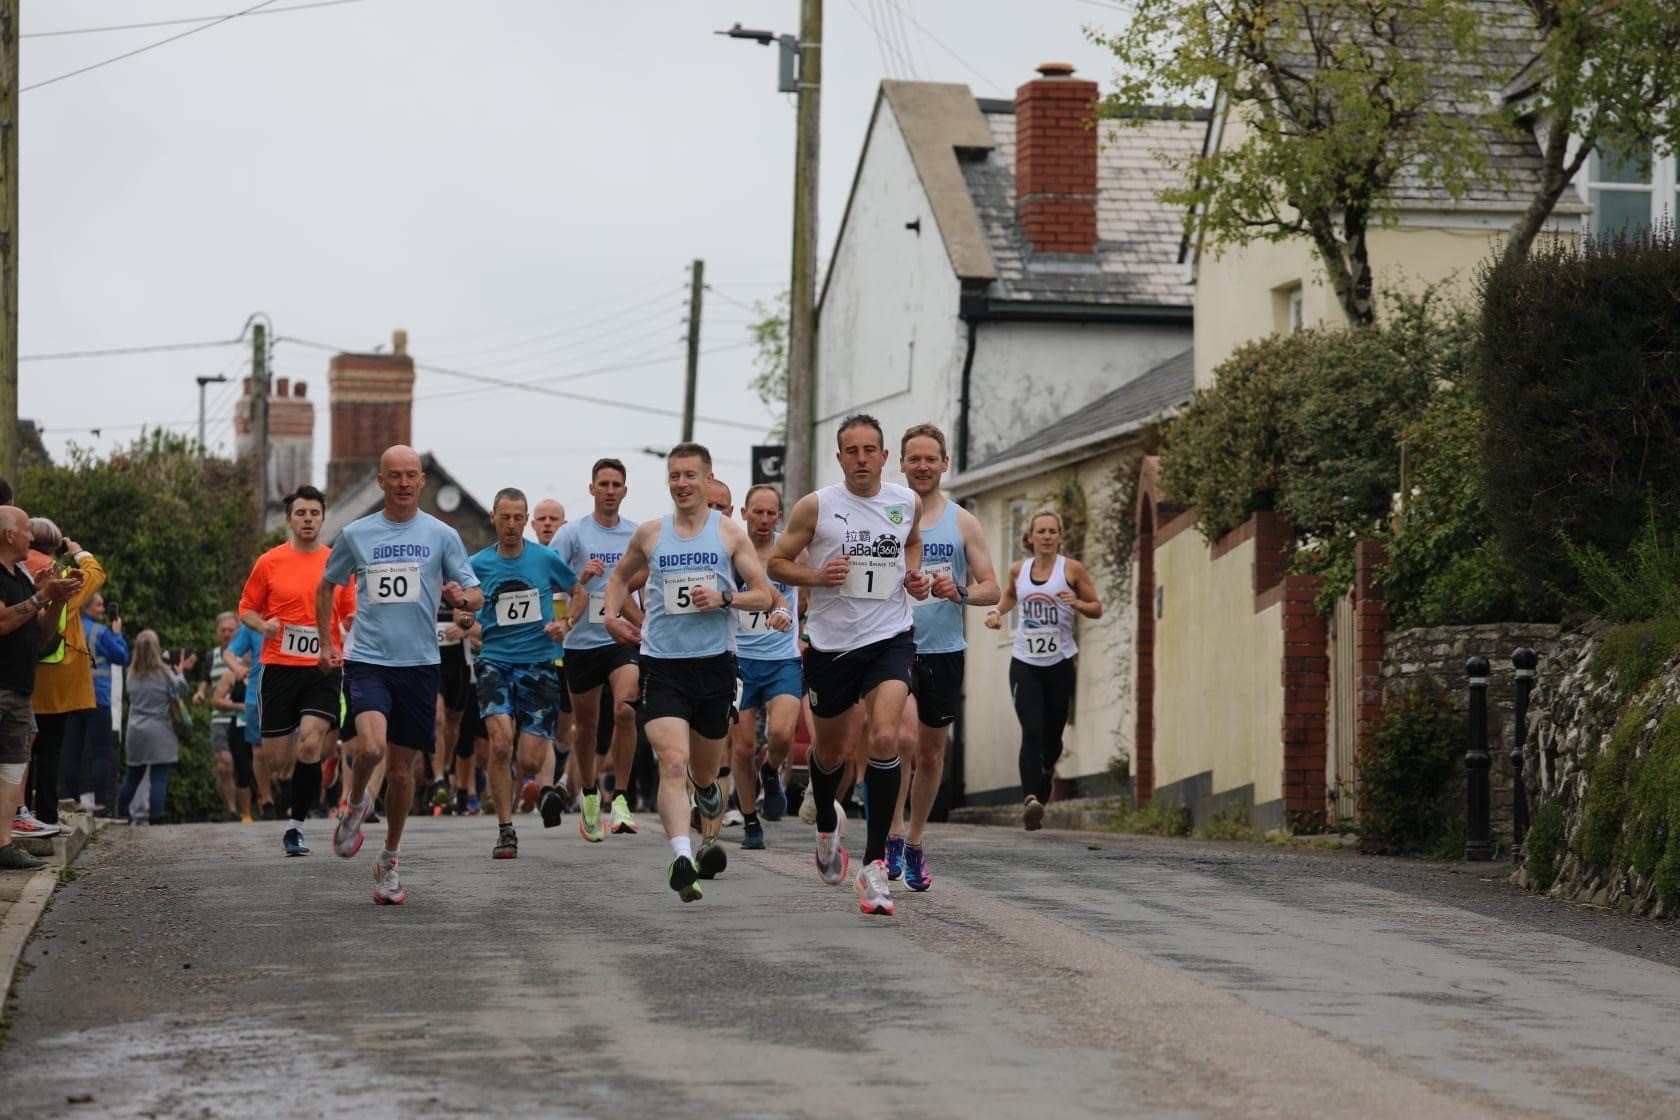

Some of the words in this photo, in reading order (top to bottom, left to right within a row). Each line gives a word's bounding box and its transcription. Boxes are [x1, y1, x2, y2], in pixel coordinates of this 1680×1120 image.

[373, 544, 430, 560] BIDEFORD
[842, 543, 871, 556] LaBa
[880, 545, 897, 555] 360
[922, 543, 954, 557] FORD
[659, 552, 719, 568] BIDEFORD
[378, 575, 408, 598] 50
[865, 571, 874, 593] 1
[508, 601, 529, 620] 67
[1023, 601, 1058, 625] MOJO
[288, 633, 319, 654] 100
[1027, 637, 1057, 654] 126
